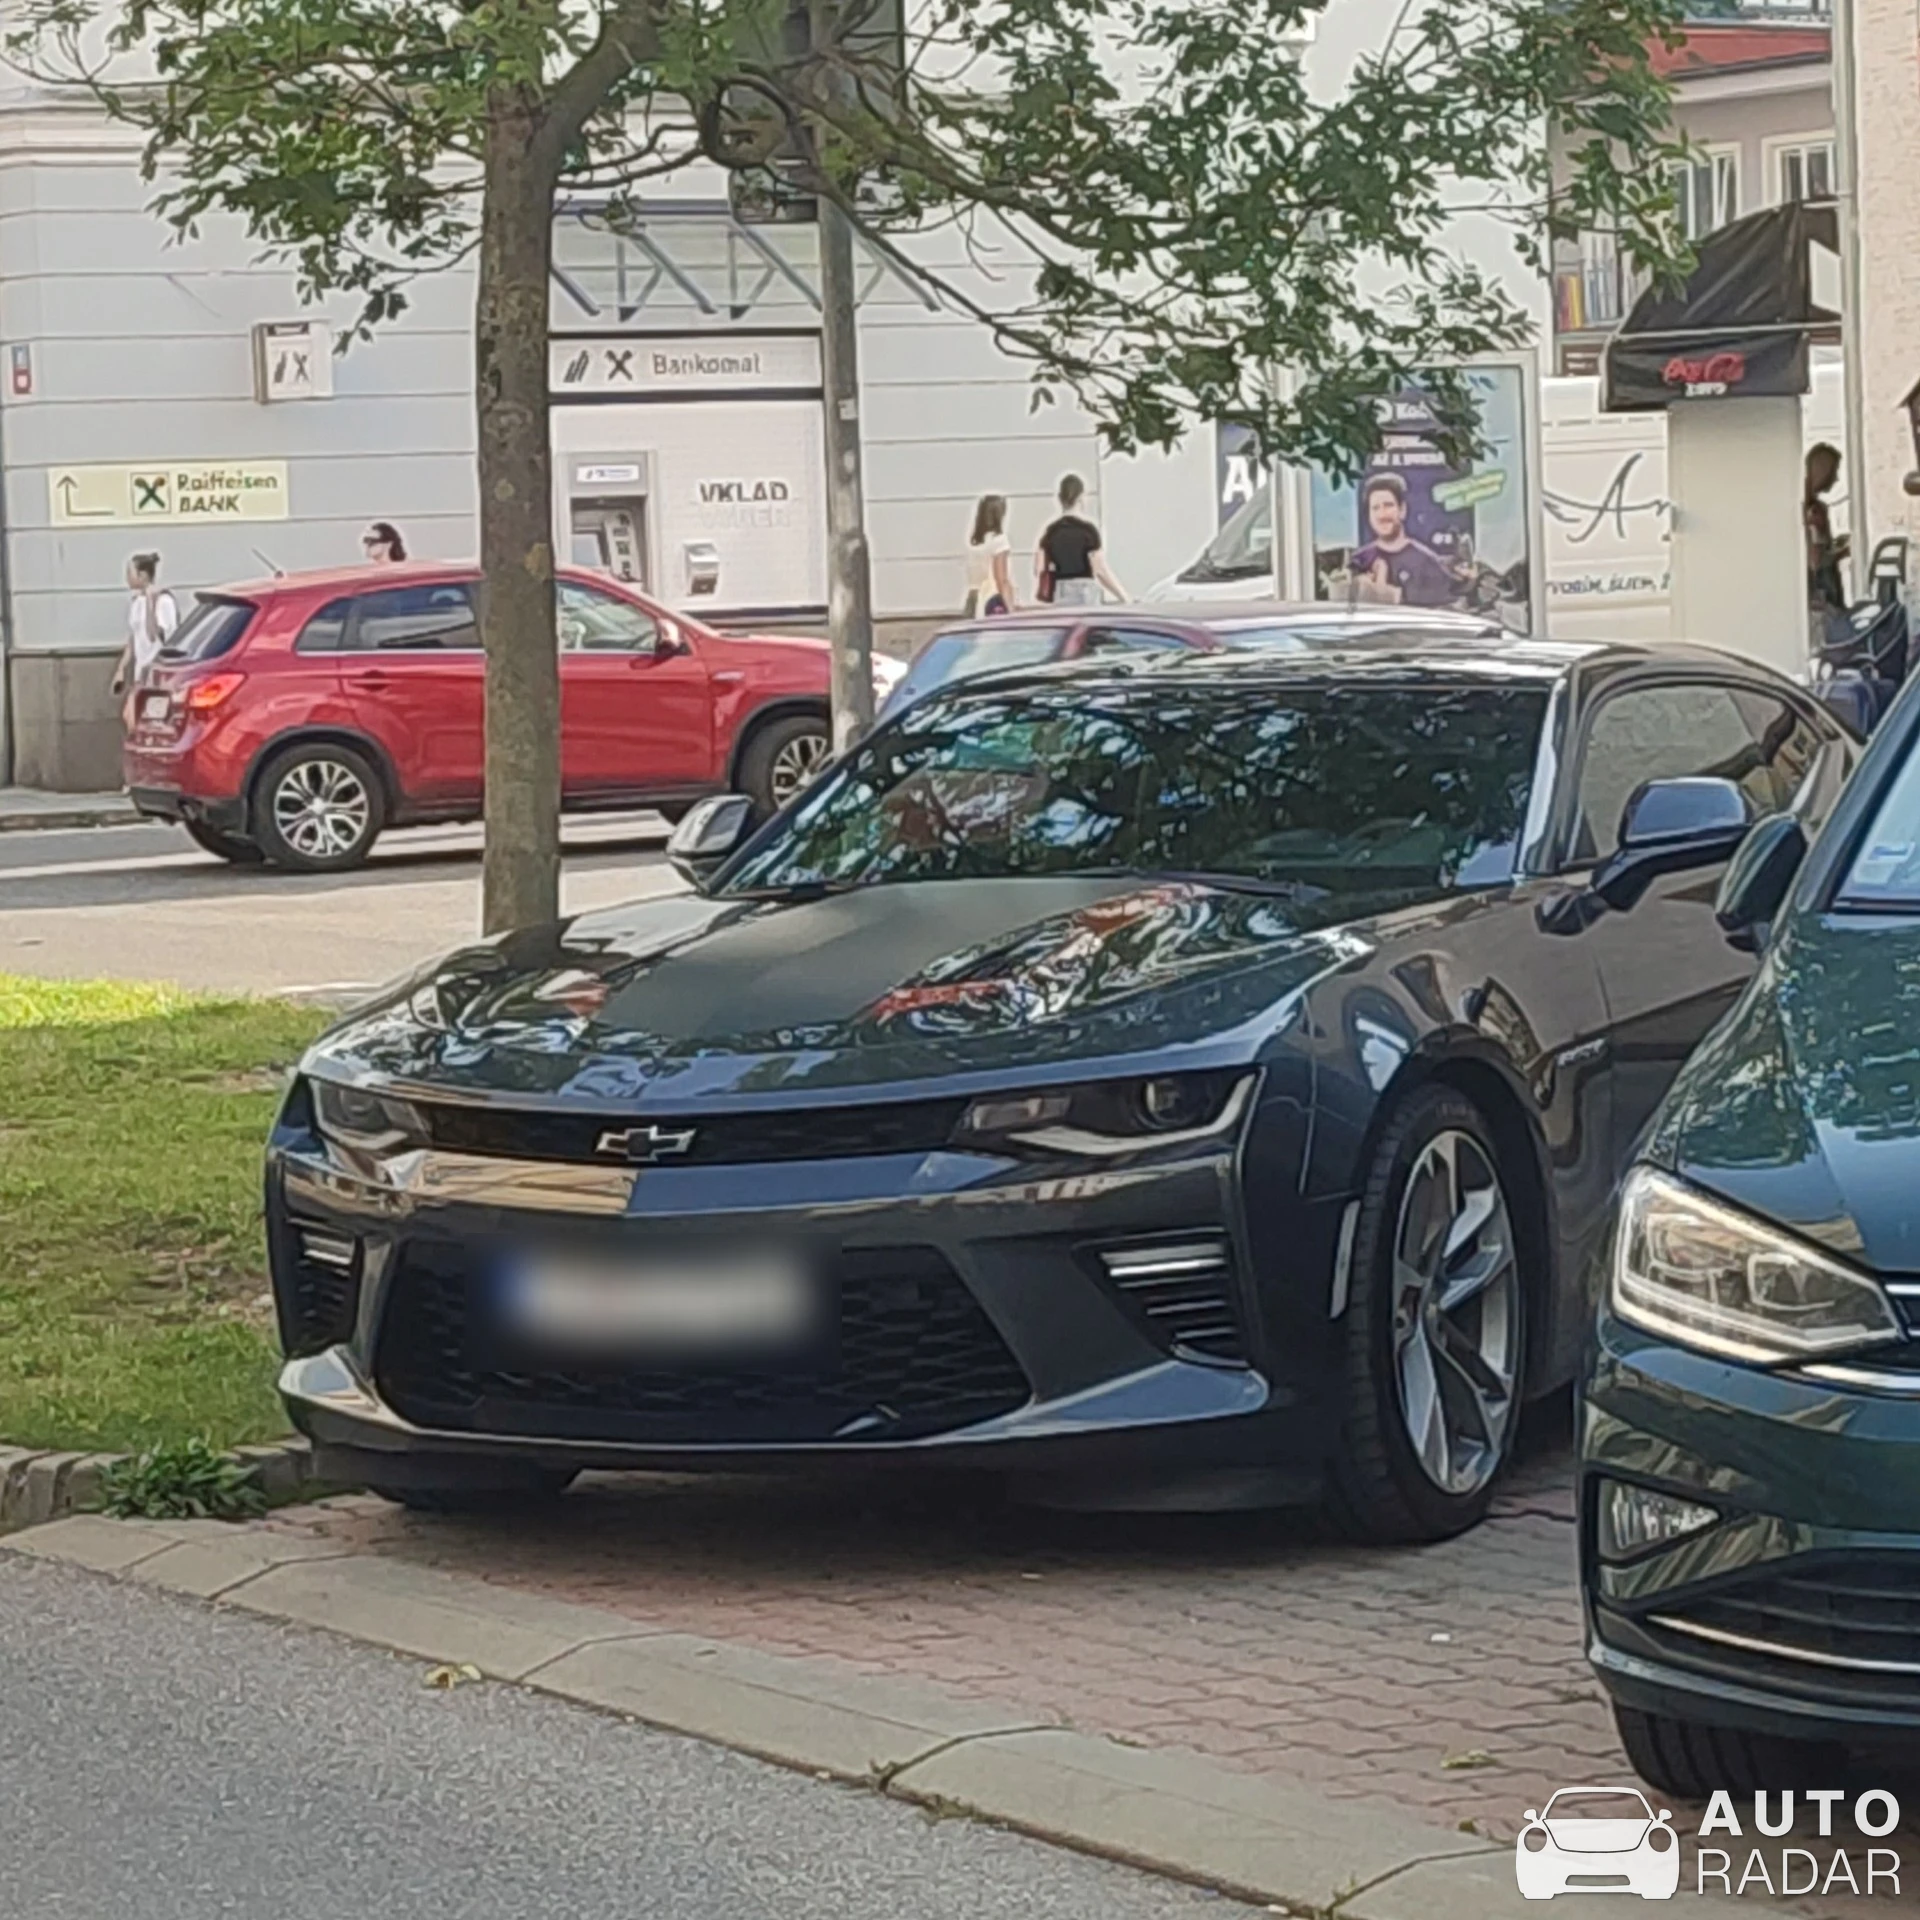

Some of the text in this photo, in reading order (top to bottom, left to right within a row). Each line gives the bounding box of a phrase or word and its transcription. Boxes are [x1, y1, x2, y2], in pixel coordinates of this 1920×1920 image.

[652, 352, 762, 376] Bankomat
[177, 469, 278, 491] Raiffeisen
[700, 481, 788, 502] VKLAD
[179, 494, 240, 513] BANK
